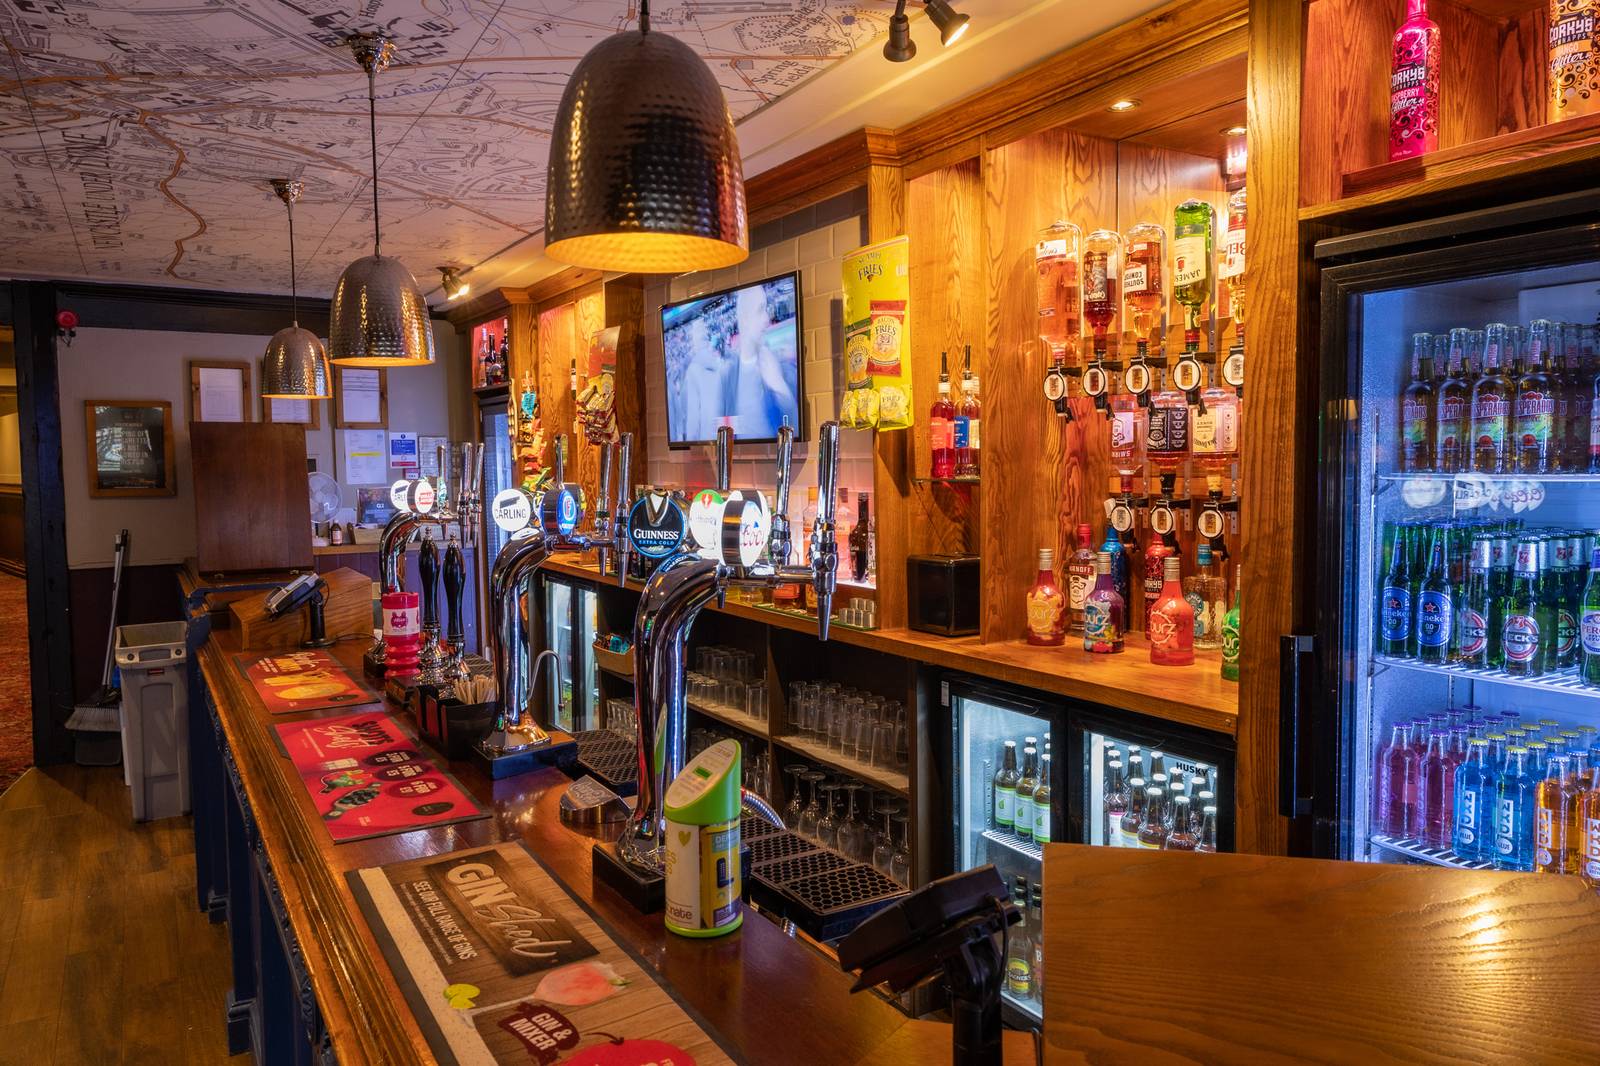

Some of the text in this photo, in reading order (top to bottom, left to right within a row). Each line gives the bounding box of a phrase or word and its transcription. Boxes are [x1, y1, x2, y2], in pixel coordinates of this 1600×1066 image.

[752, 60, 799, 85] Spring
[774, 65, 815, 88] Fields
[79, 171, 116, 202] UNDER
[82, 202, 124, 250] NEWCASTLE
[858, 264, 883, 281] FRIES
[875, 325, 897, 336] FRIES
[495, 509, 527, 520] CARLING
[634, 528, 680, 540] GUINNESS
[1175, 761, 1210, 777] HUSKY
[413, 880, 433, 892] SEE
[420, 890, 441, 903] OUR
[427, 901, 450, 916] FULL
[447, 862, 574, 958] GIN Shed
[436, 914, 462, 936] RANGE
[448, 933, 468, 943] OF
[453, 941, 479, 960] GINS
[508, 1016, 558, 1051] MIXER
[530, 1011, 568, 1042] GIN &
